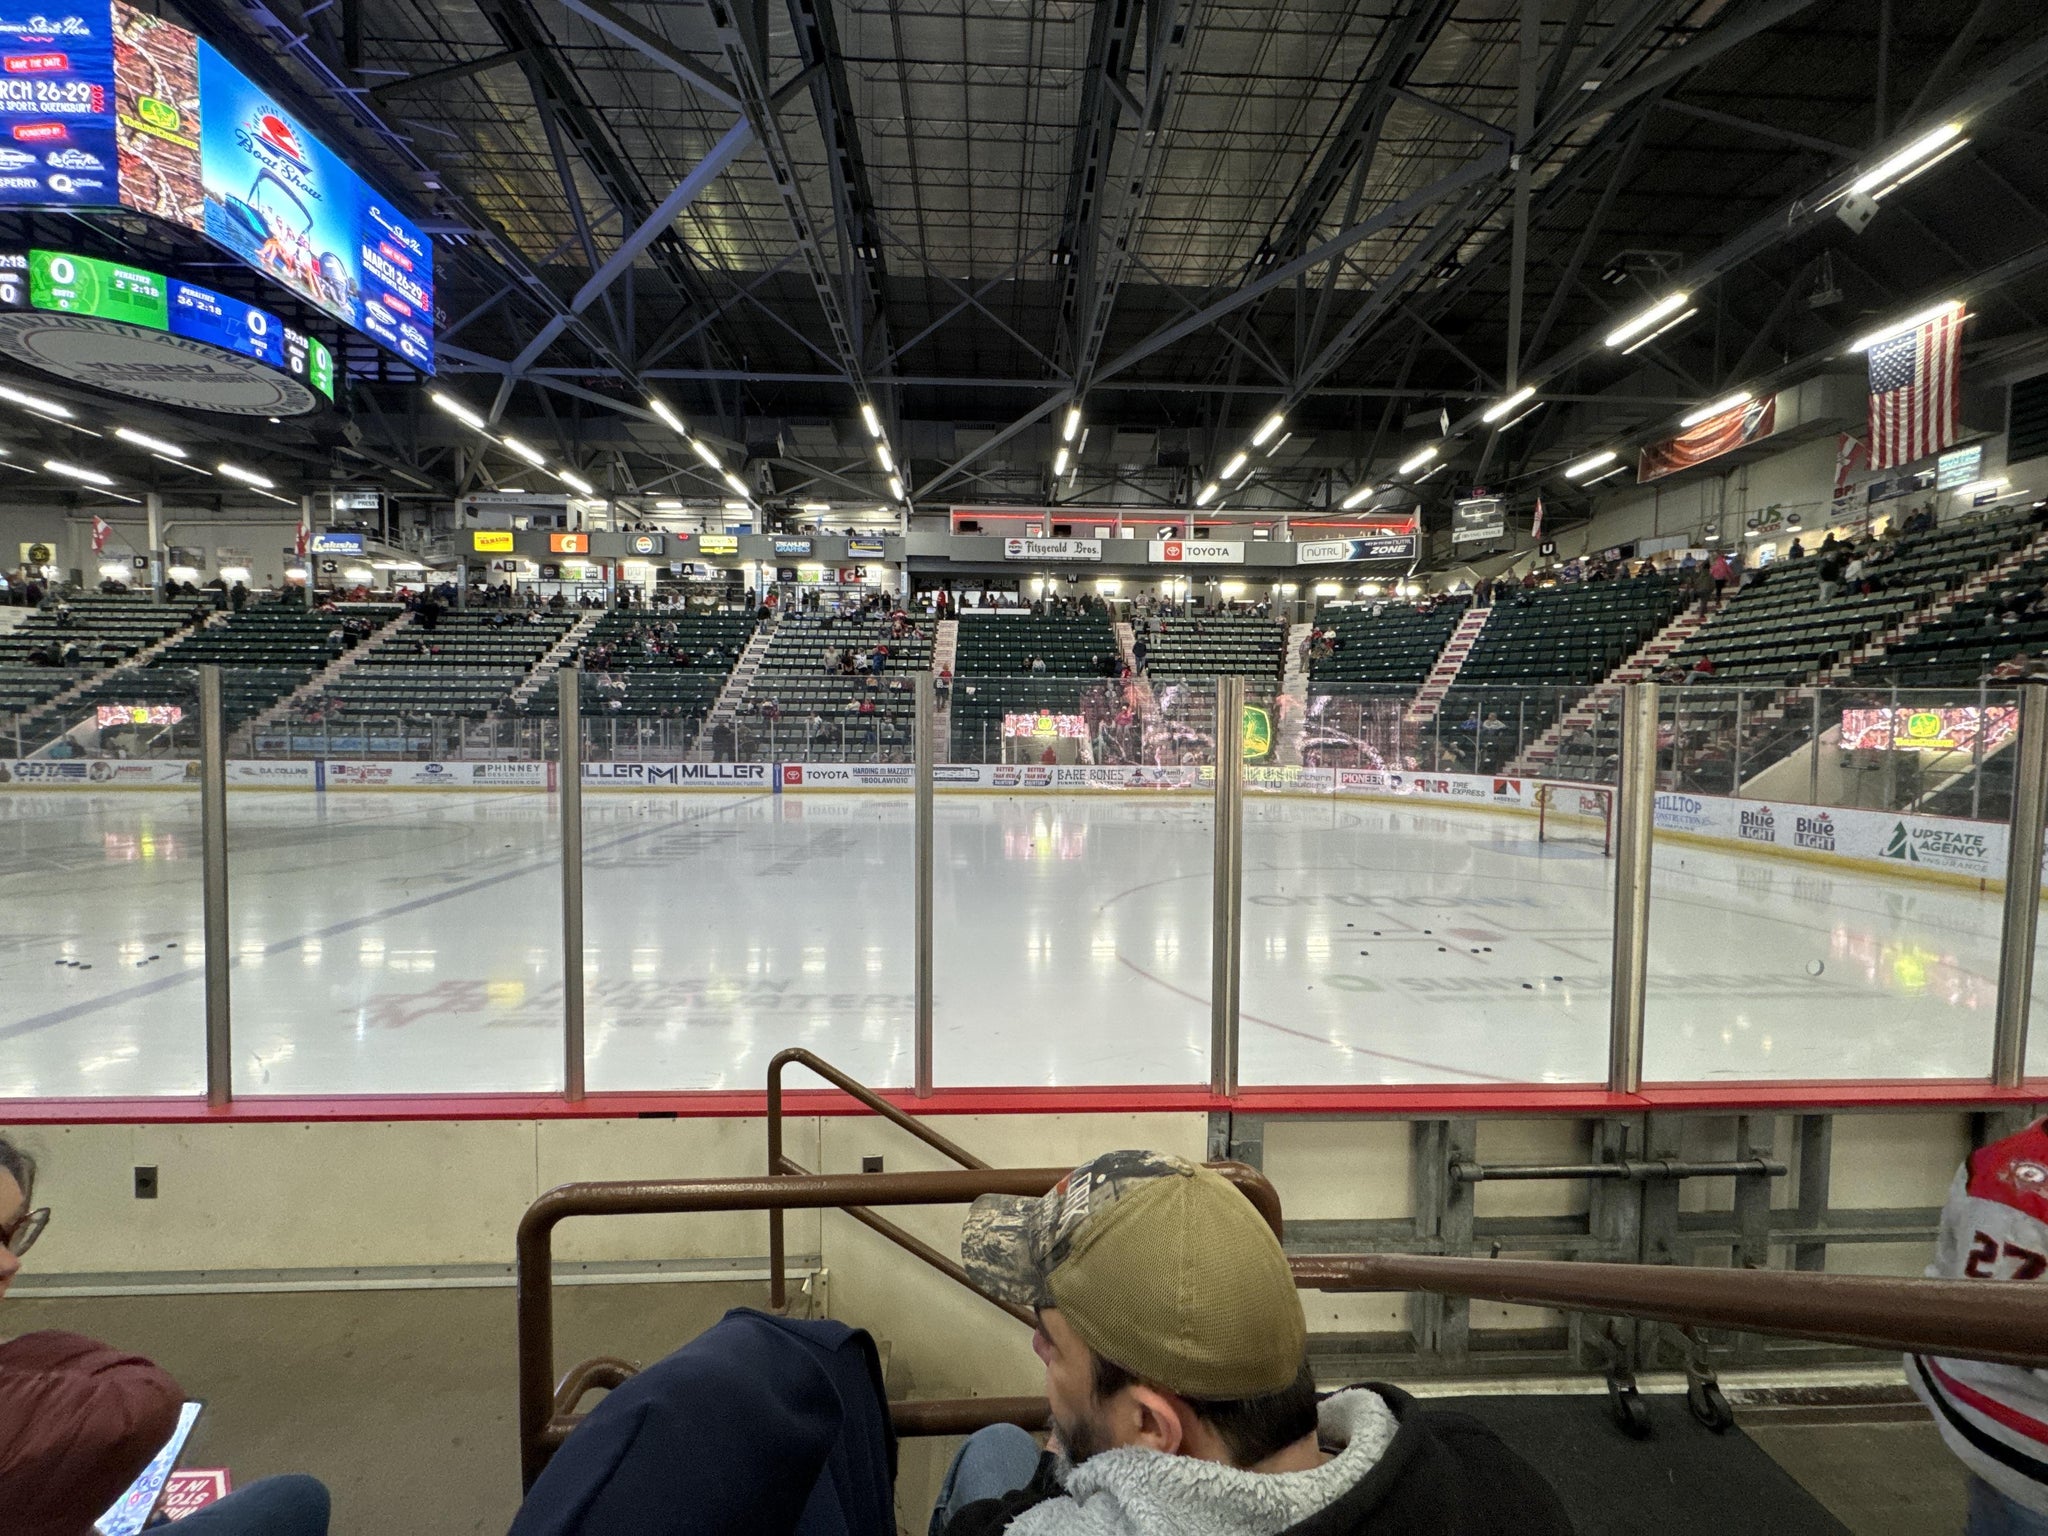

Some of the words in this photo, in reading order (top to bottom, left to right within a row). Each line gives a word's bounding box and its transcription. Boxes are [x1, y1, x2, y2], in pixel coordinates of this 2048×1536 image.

[0, 81, 33, 100] RCH
[36, 81, 91, 102] 26-29
[234, 127, 278, 170] Boat
[280, 158, 324, 202] Show
[0, 254, 27, 269] 7:18
[362, 244, 396, 280] MARCH
[50, 257, 75, 285] 0
[115, 279, 126, 290] 2
[177, 295, 194, 307] 36
[246, 310, 267, 337] 0
[290, 356, 304, 374] 0
[315, 347, 327, 371] 0
[1074, 542, 1100, 554] Bros.
[1187, 547, 1230, 557] TOYOTA
[1369, 545, 1407, 555] ZONE
[1542, 544, 1553, 554] U
[135, 558, 145, 568] D
[505, 562, 515, 571] B
[683, 566, 692, 574] A
[856, 567, 866, 577] X
[1067, 573, 1078, 582] W
[14, 762, 75, 778] CDTA
[487, 765, 541, 773] PHINNEY
[682, 764, 764, 778] MILLER
[806, 770, 849, 780] TOYOTA
[852, 767, 879, 775] HARDING
[1057, 769, 1087, 781] BARE
[1089, 769, 1124, 781] BONES
[1342, 772, 1385, 785] PIONEER
[1451, 781, 1469, 789] TIRE
[1451, 788, 1486, 798] EXPRESS
[1653, 794, 1702, 814] HILLTOP
[1740, 811, 1775, 828] Blue
[1796, 817, 1835, 836] Blue
[1739, 825, 1775, 842] LIGHT
[1911, 828, 1985, 847] UPSTATE
[1794, 832, 1836, 851] LIGHT
[1919, 840, 1987, 858] AGENCY
[1922, 856, 1989, 873] INSURANCE
[1964, 1230, 2047, 1280] 27
[185, 1479, 211, 1492] IN
[167, 1492, 209, 1507] STO
